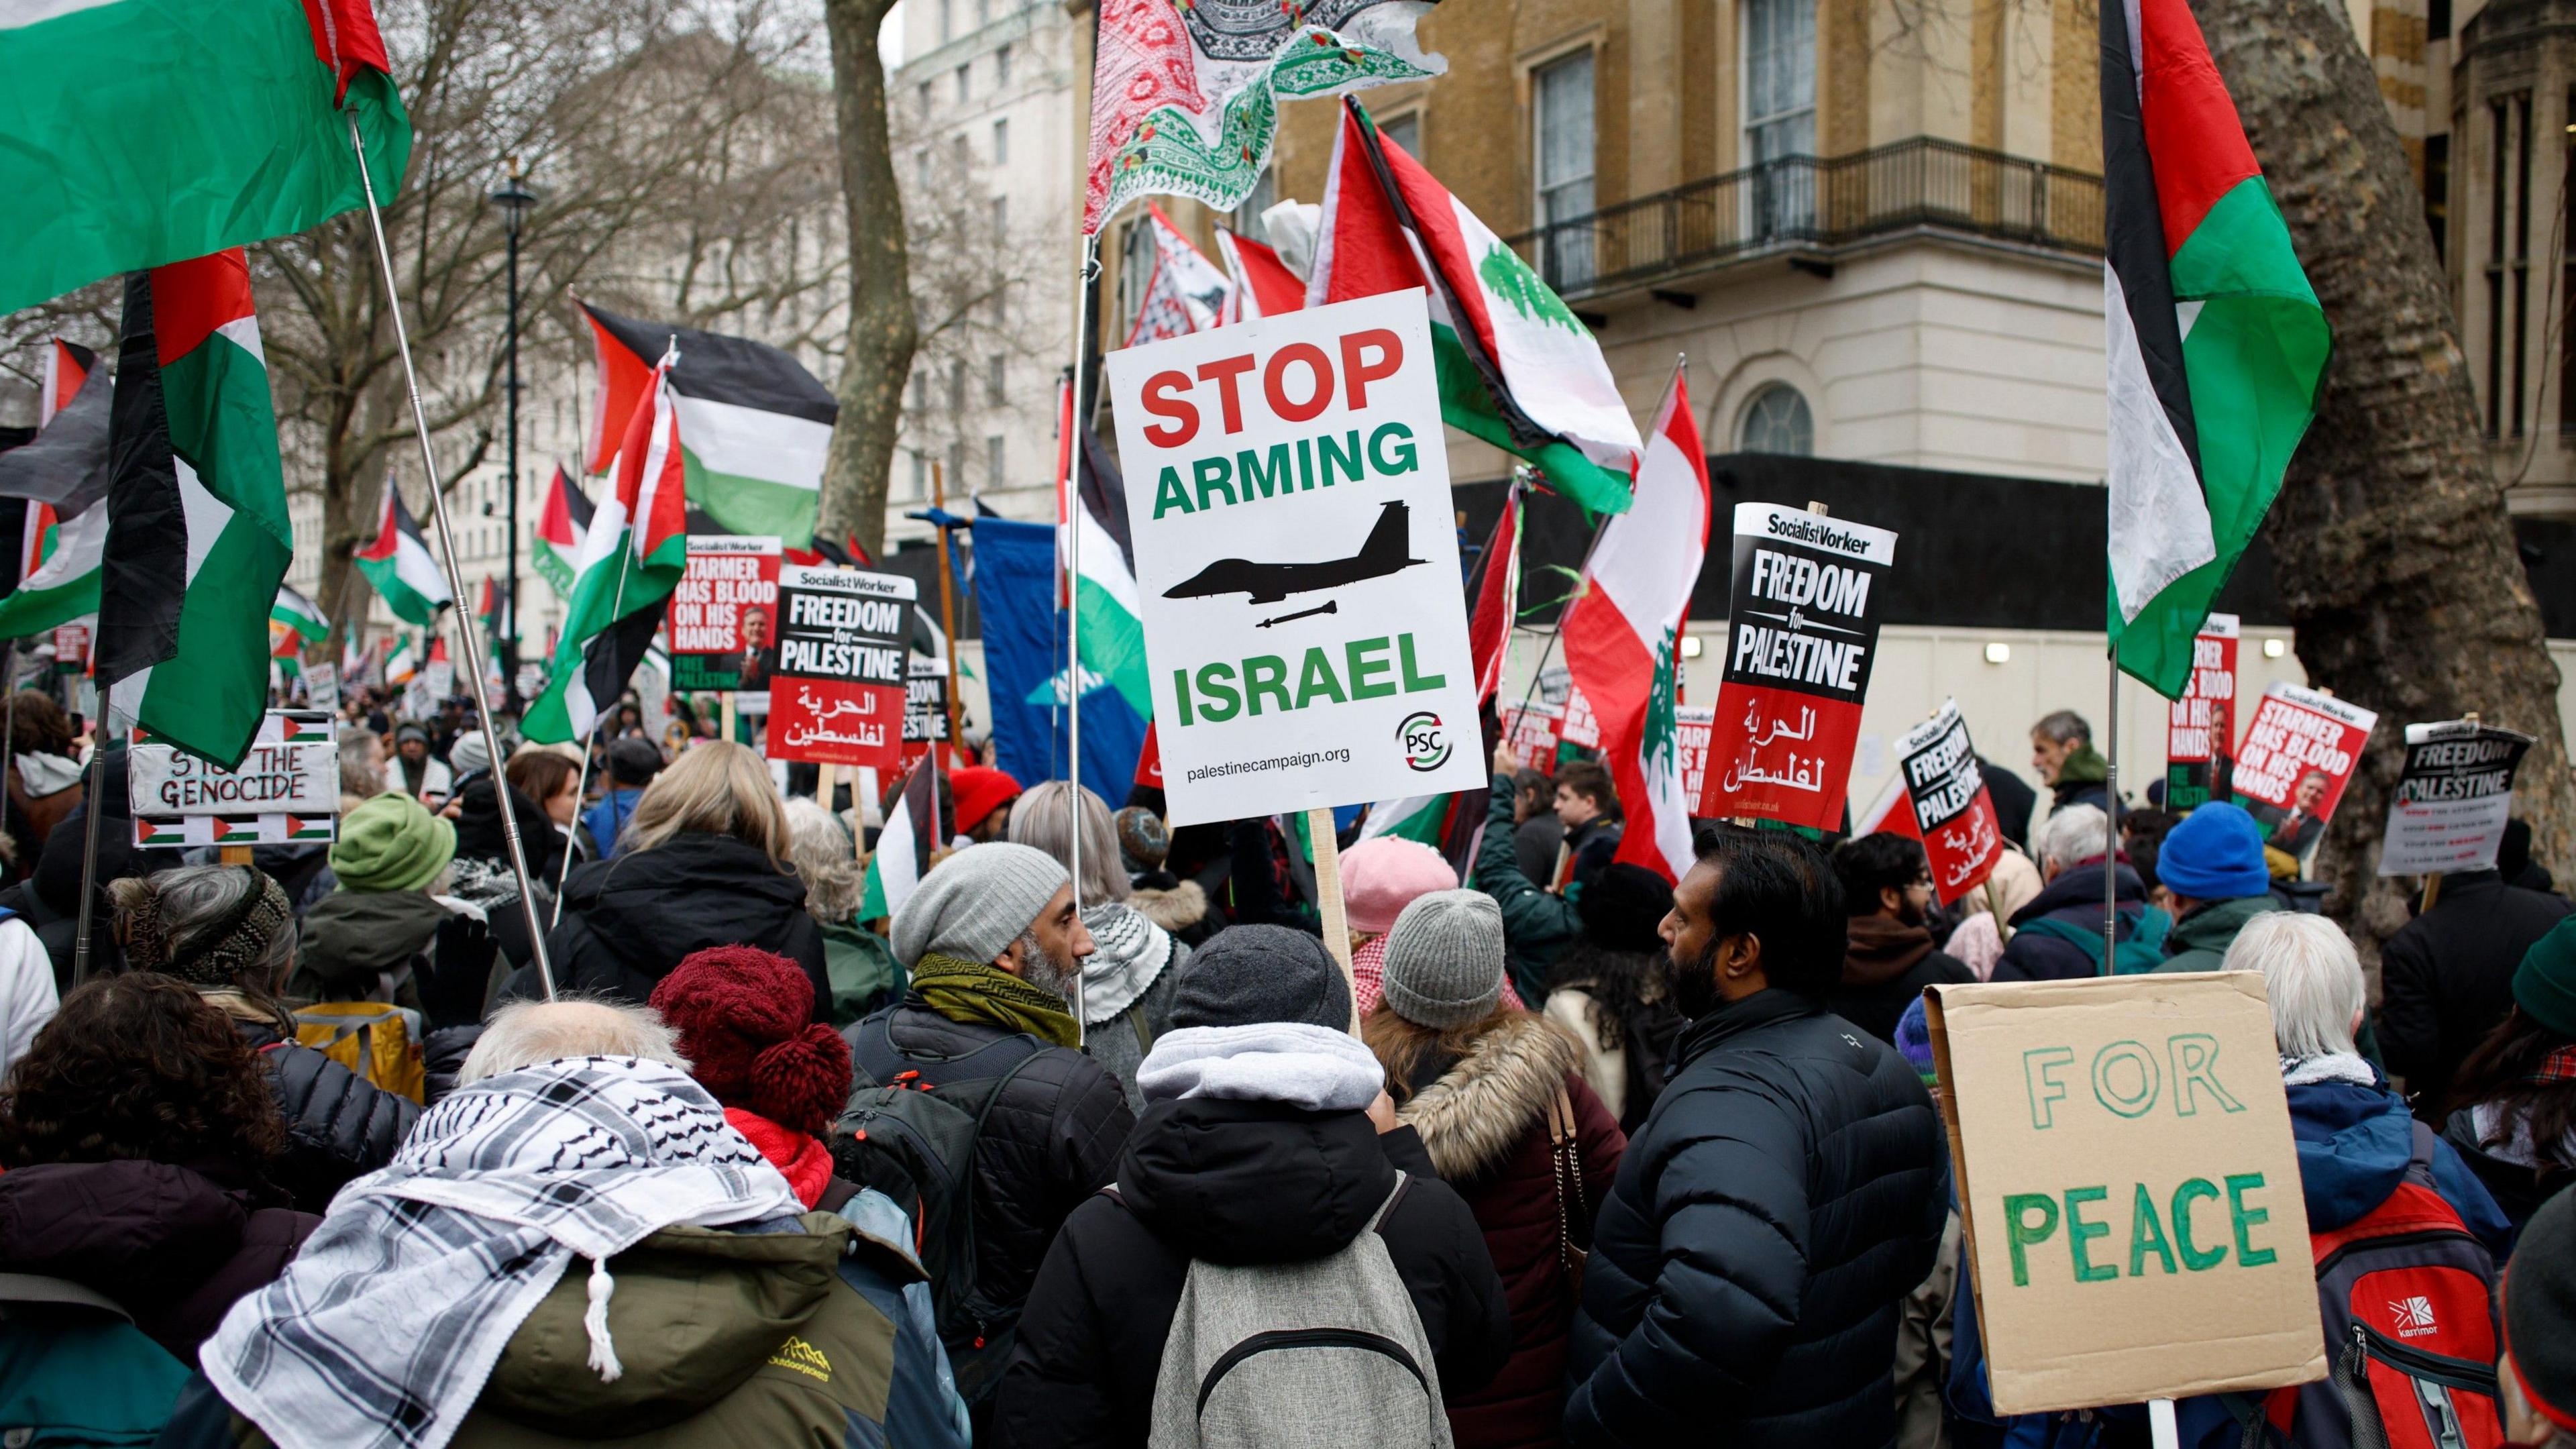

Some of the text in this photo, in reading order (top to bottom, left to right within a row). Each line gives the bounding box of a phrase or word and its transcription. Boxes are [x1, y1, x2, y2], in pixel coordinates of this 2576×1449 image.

[1141, 328, 1403, 448] STOP
[1152, 422, 1419, 520] ARMING
[683, 556, 760, 580] TARMER
[800, 572, 897, 593] Socialist Worker
[1752, 548, 1872, 618] FREEDOM
[675, 580, 777, 604] HAS BLOOD
[674, 603, 737, 627] ON HIS
[790, 593, 901, 634] FREEDOM
[675, 626, 737, 651] HANDS
[833, 628, 853, 644] for
[780, 639, 902, 681] PALESTINE
[1733, 624, 1865, 691] PALESTINE
[1173, 633, 1446, 727] ISRAEL
[797, 684, 877, 719] الحرية
[784, 716, 885, 747] لفلسطين
[1743, 698, 1817, 746] الحرية
[2259, 700, 2345, 749] STARMER
[252, 745, 303, 773] THE
[1406, 731, 1444, 754] PSC
[2170, 728, 2212, 757] HANDS
[2249, 720, 2351, 776] HAS BLOOD
[2413, 739, 2515, 769] FREEDOM
[1187, 747, 1350, 784] palestinecampaign.org
[1723, 747, 1825, 792] لفلسطين
[2240, 743, 2302, 783] ON HIS
[160, 773, 309, 808] GENOCIDE
[2232, 762, 2291, 804] HANDS
[2023, 1032, 2247, 1130] FOR
[2003, 1171, 2278, 1287] PEACE
[2398, 1326, 2438, 1338] karrimor
